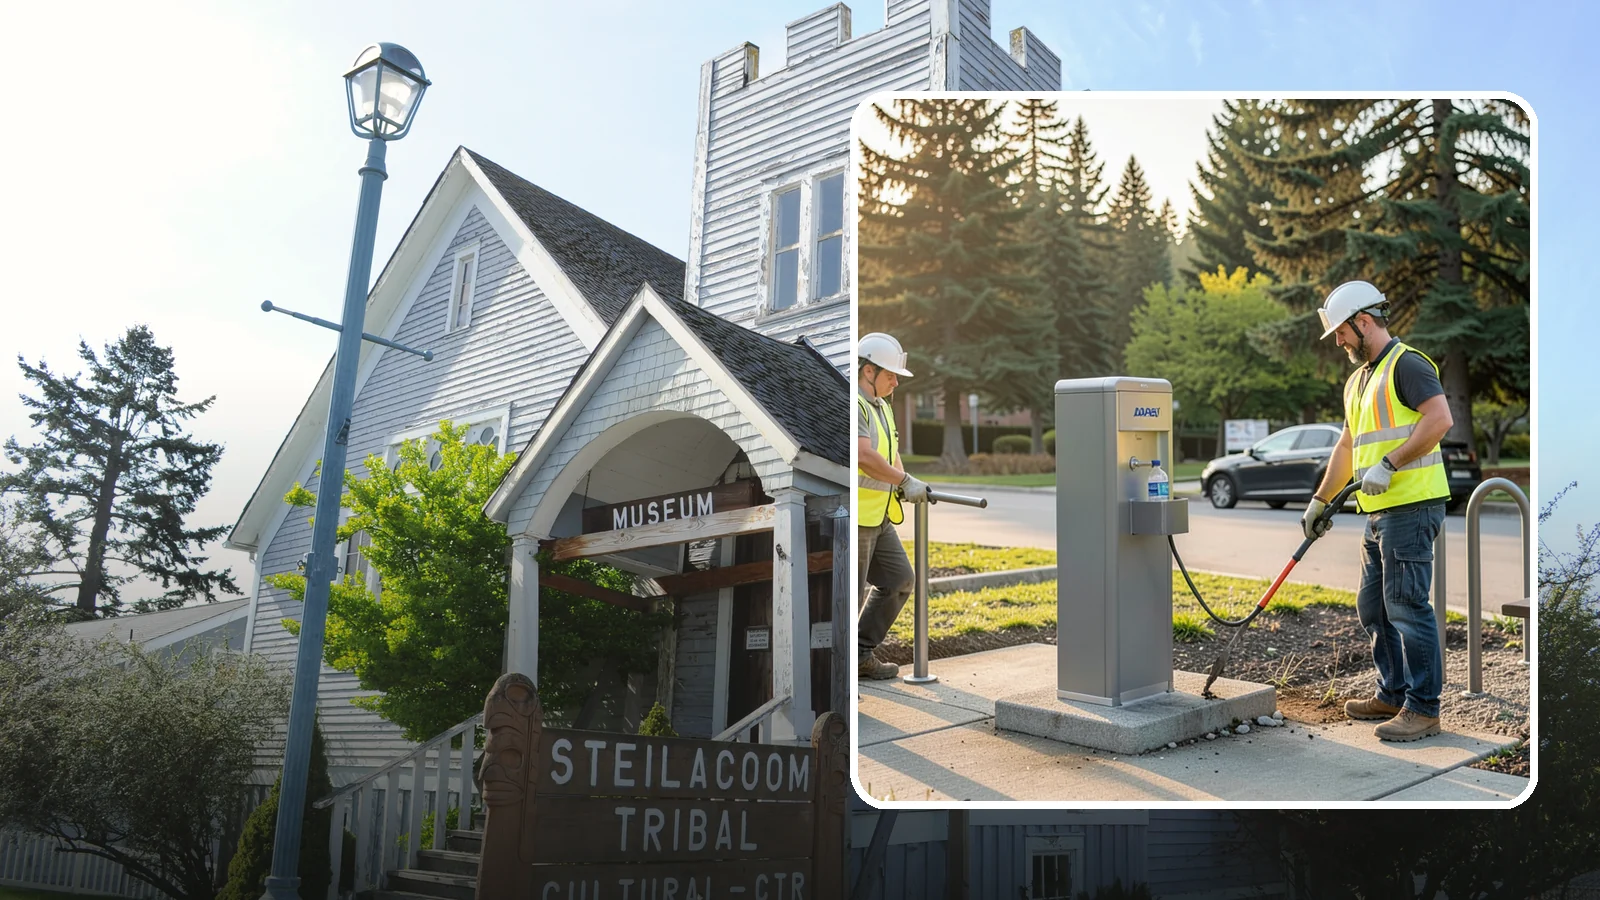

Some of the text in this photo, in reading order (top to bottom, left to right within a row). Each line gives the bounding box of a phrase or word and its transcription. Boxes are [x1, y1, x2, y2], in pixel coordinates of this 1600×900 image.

[613, 491, 714, 531] MUSEUM
[550, 737, 810, 793] STEILACOOM
[615, 806, 758, 852] TRIBAL
